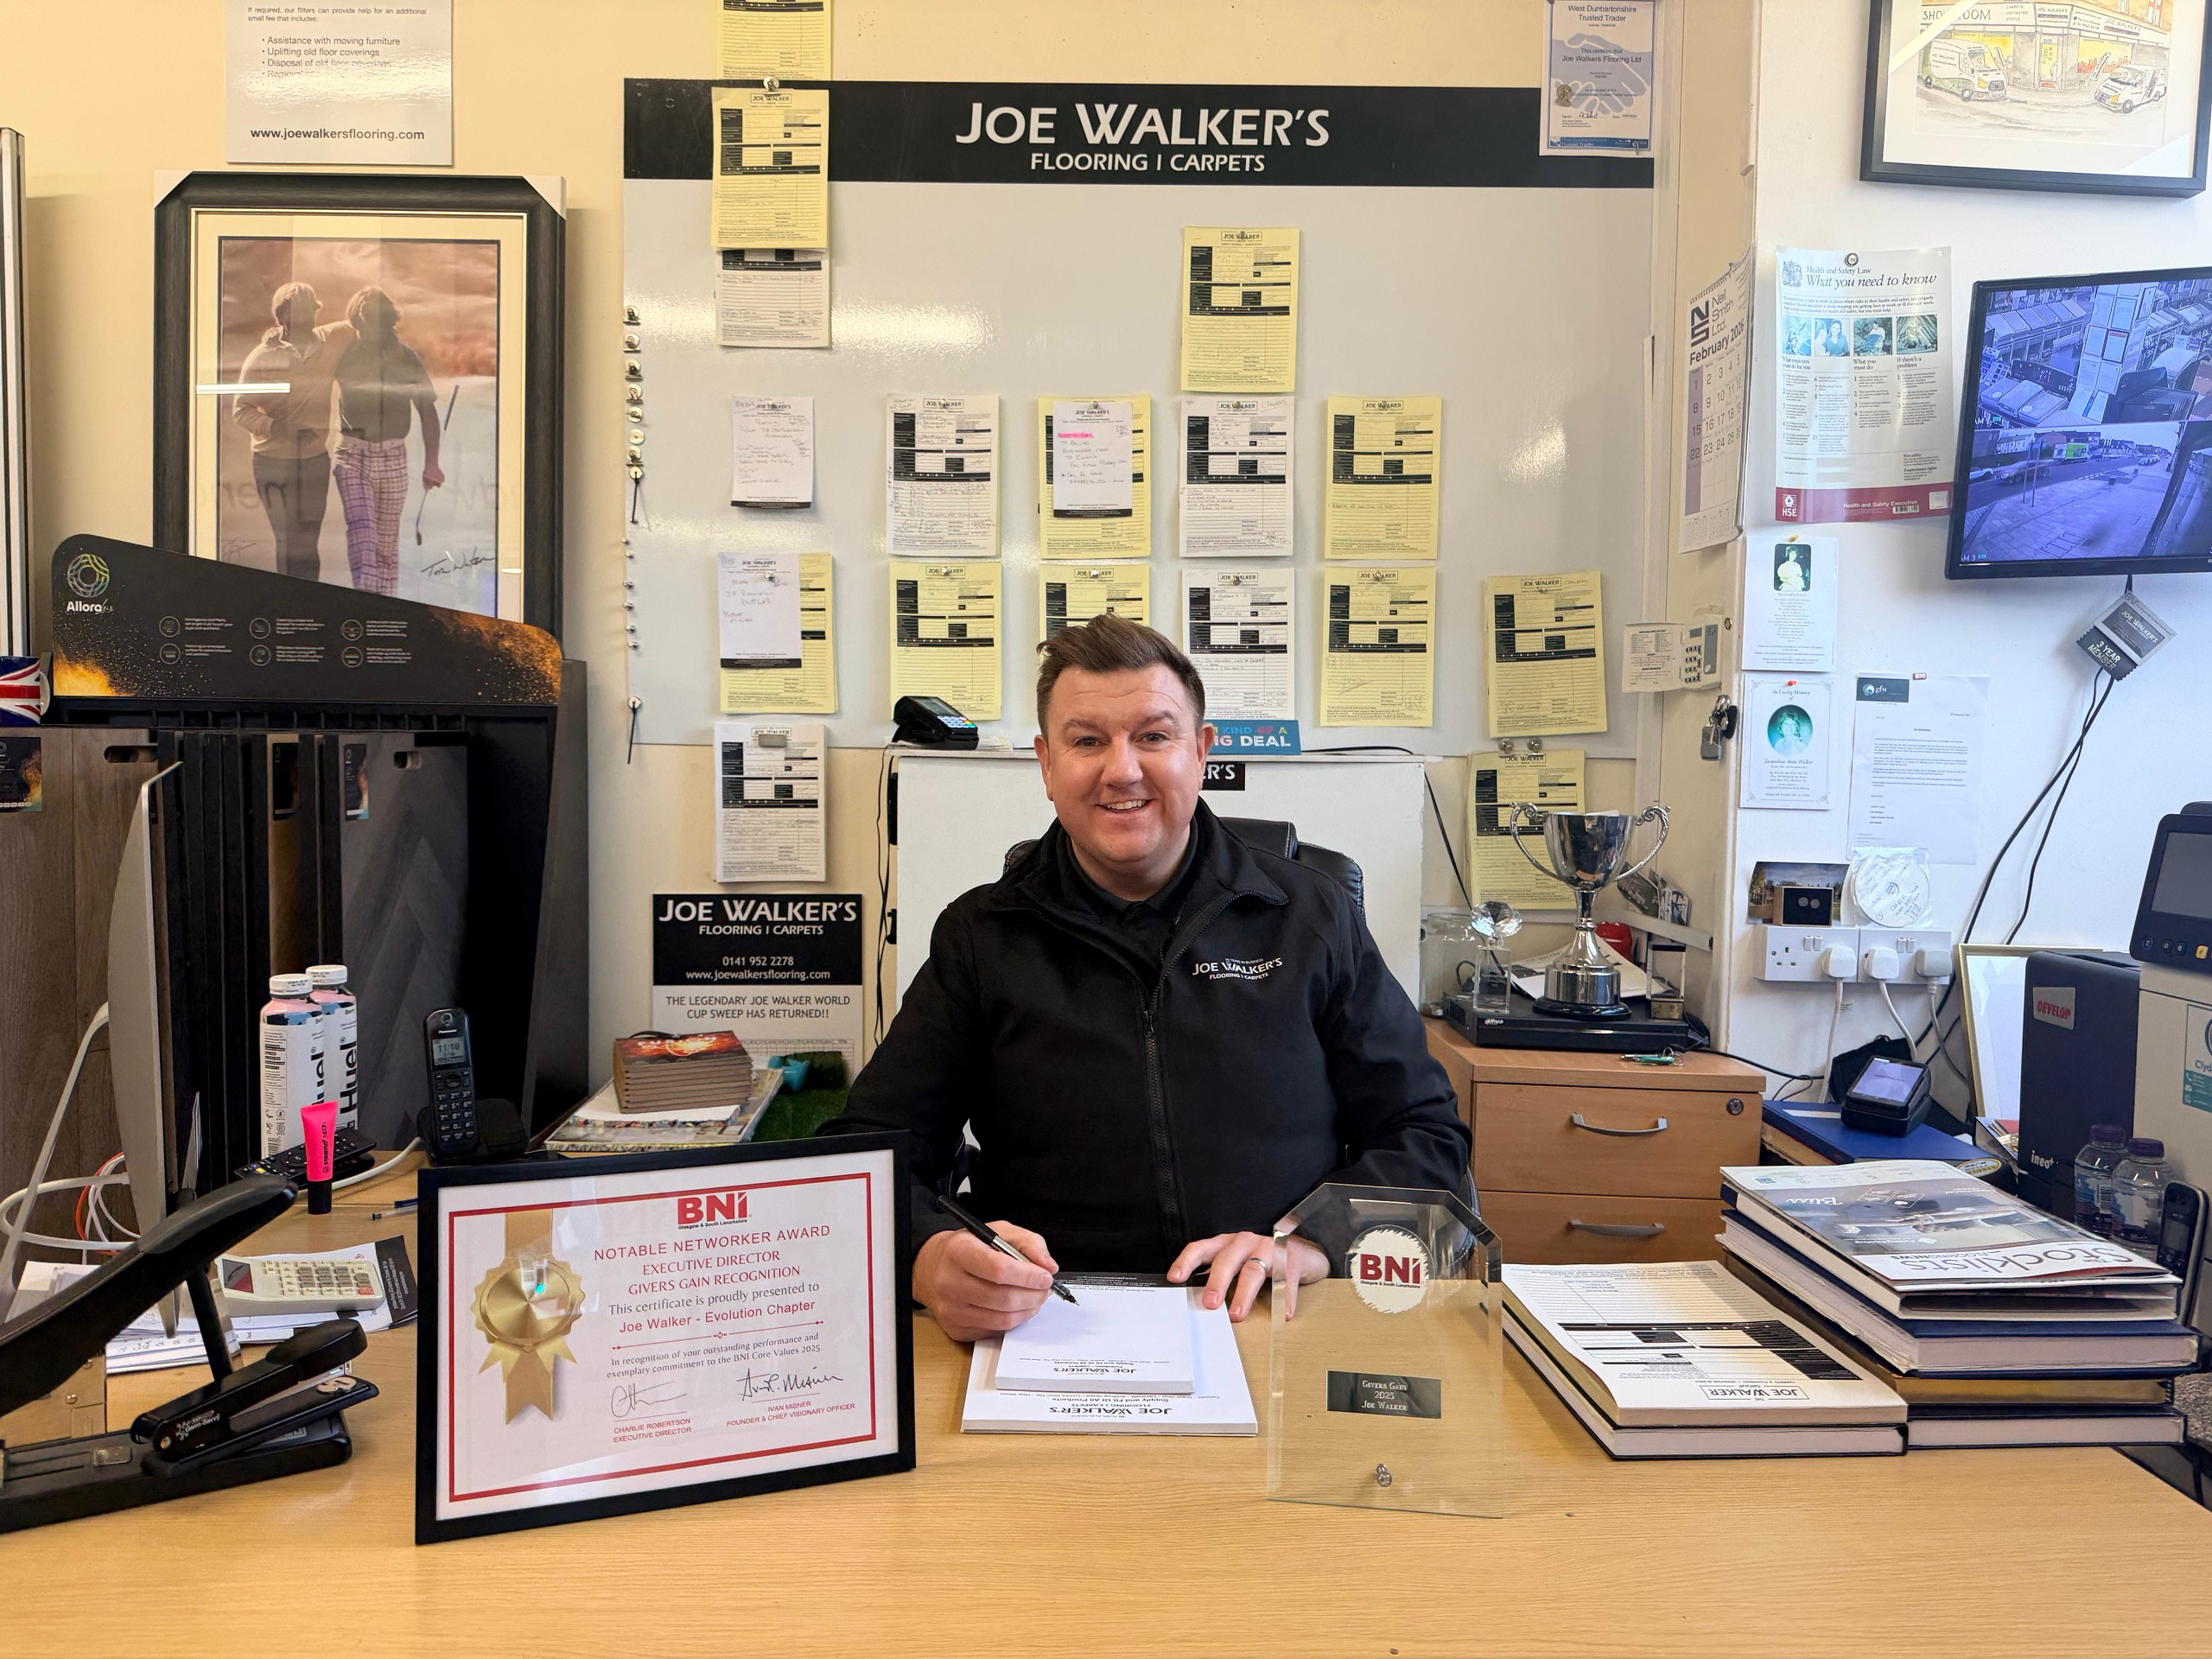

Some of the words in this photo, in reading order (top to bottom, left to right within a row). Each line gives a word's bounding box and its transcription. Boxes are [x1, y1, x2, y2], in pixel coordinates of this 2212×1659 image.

[332, 7, 355, 16] provide
[358, 7, 372, 16] help
[267, 36, 312, 45] Assistance
[314, 36, 332, 45] with
[334, 37, 364, 47] moving
[365, 37, 401, 46] furniture
[267, 48, 302, 57] Uplifting
[340, 48, 380, 57] coverings
[955, 102, 1058, 144] JOE
[1075, 102, 1331, 148] WALKER'S
[251, 128, 425, 142] www.joewalkersflooring.com
[1031, 152, 1148, 172] FLOORING
[1170, 153, 1266, 173] CARPETS
[1807, 265, 1825, 275] Health
[1826, 266, 1837, 275] and
[1838, 267, 1856, 276] Safety
[1807, 274, 1833, 288] What
[1834, 278, 1854, 290] you
[1858, 276, 1884, 288] need
[1887, 276, 1899, 287] to
[1902, 273, 1937, 286] know
[1712, 289, 1726, 308] Neil
[1712, 299, 1734, 322] Smith
[1689, 334, 1730, 365] February
[1782, 508, 1797, 517] HSE
[67, 601, 102, 613] Allora
[2121, 610, 2133, 621] JOE
[2088, 644, 2117, 671] MEMBER
[2103, 645, 2121, 664] YEAR
[1214, 735, 1233, 747] IG
[1240, 735, 1292, 747] DEAL
[658, 899, 714, 922] JOE
[722, 899, 857, 922] WALKER'S
[699, 925, 762, 936] FLOORING
[772, 925, 824, 936] CARPETS
[722, 956, 746, 967] 0141
[749, 956, 767, 966] 952
[770, 956, 794, 966] 2278
[1192, 962, 1219, 976] JOE
[1221, 957, 1283, 975] WALKER'S
[686, 969, 830, 982] www.joewalkersflooring.com
[1244, 971, 1269, 981] CARPETS
[666, 995, 686, 1006] THE
[689, 995, 747, 1006] LEGENDARY
[750, 995, 768, 1006] JOE
[772, 995, 811, 1006] WALKER
[815, 995, 851, 1005] WORLD
[687, 1009, 708, 1019] CUP
[710, 1009, 743, 1019] SWEEP
[747, 1009, 766, 1019] HAS
[769, 1008, 830, 1019] RETURNED!!
[2037, 1000, 2071, 1020] DEVELOP
[677, 1192, 748, 1225] BNI
[1786, 1196, 1843, 1206] Bliss
[594, 1243, 668, 1262] NOTABLE
[673, 1231, 772, 1253] NETWORKER
[777, 1224, 831, 1243] AWARD
[643, 1257, 713, 1276] EXECUTIVE
[716, 1250, 780, 1268] DIRECTOR
[1360, 1253, 1421, 1285] BNI
[1901, 1247, 2134, 1274] Stocklists
[628, 1280, 676, 1296] GIVERS
[679, 1276, 710, 1290] GAIN
[714, 1265, 801, 1286] RECOGNITION
[608, 1303, 632, 1316] This
[635, 1297, 692, 1313] certificate
[696, 1294, 704, 1306] is
[708, 1289, 749, 1307] proudly
[752, 1283, 805, 1302] presented
[808, 1282, 820, 1293] to
[619, 1321, 643, 1333] Joe
[646, 1316, 692, 1330] Walker
[705, 1307, 763, 1324] Evolution
[766, 1300, 816, 1317] Chapter
[611, 1357, 620, 1366] In
[622, 1351, 670, 1366] recognition
[671, 1349, 681, 1358] of
[683, 1348, 702, 1360] your
[702, 1342, 751, 1355] outstanding
[753, 1335, 803, 1350] performance
[804, 1332, 819, 1342] and
[607, 1366, 650, 1379] exemplary
[652, 1359, 705, 1374] commitment
[707, 1357, 716, 1365] to
[718, 1356, 732, 1364] the
[734, 1352, 750, 1362] BNI
[752, 1350, 772, 1360] Core
[773, 1346, 799, 1357] Values
[801, 1344, 823, 1354] 2025.
[1374, 1390, 1395, 1400] 2025
[726, 1417, 760, 1427] FOUNDER
[767, 1412, 788, 1421] CHIEF
[788, 1407, 825, 1419] VISIONARY
[826, 1402, 856, 1413] OFFICER
[767, 1404, 784, 1413] IVAN
[785, 1401, 812, 1411] MISNER
[613, 1424, 645, 1434] CHARLIE
[646, 1418, 691, 1430] ROBERTSON
[613, 1432, 654, 1443] EXECUTIVE
[655, 1427, 692, 1438] DIRECTOR
